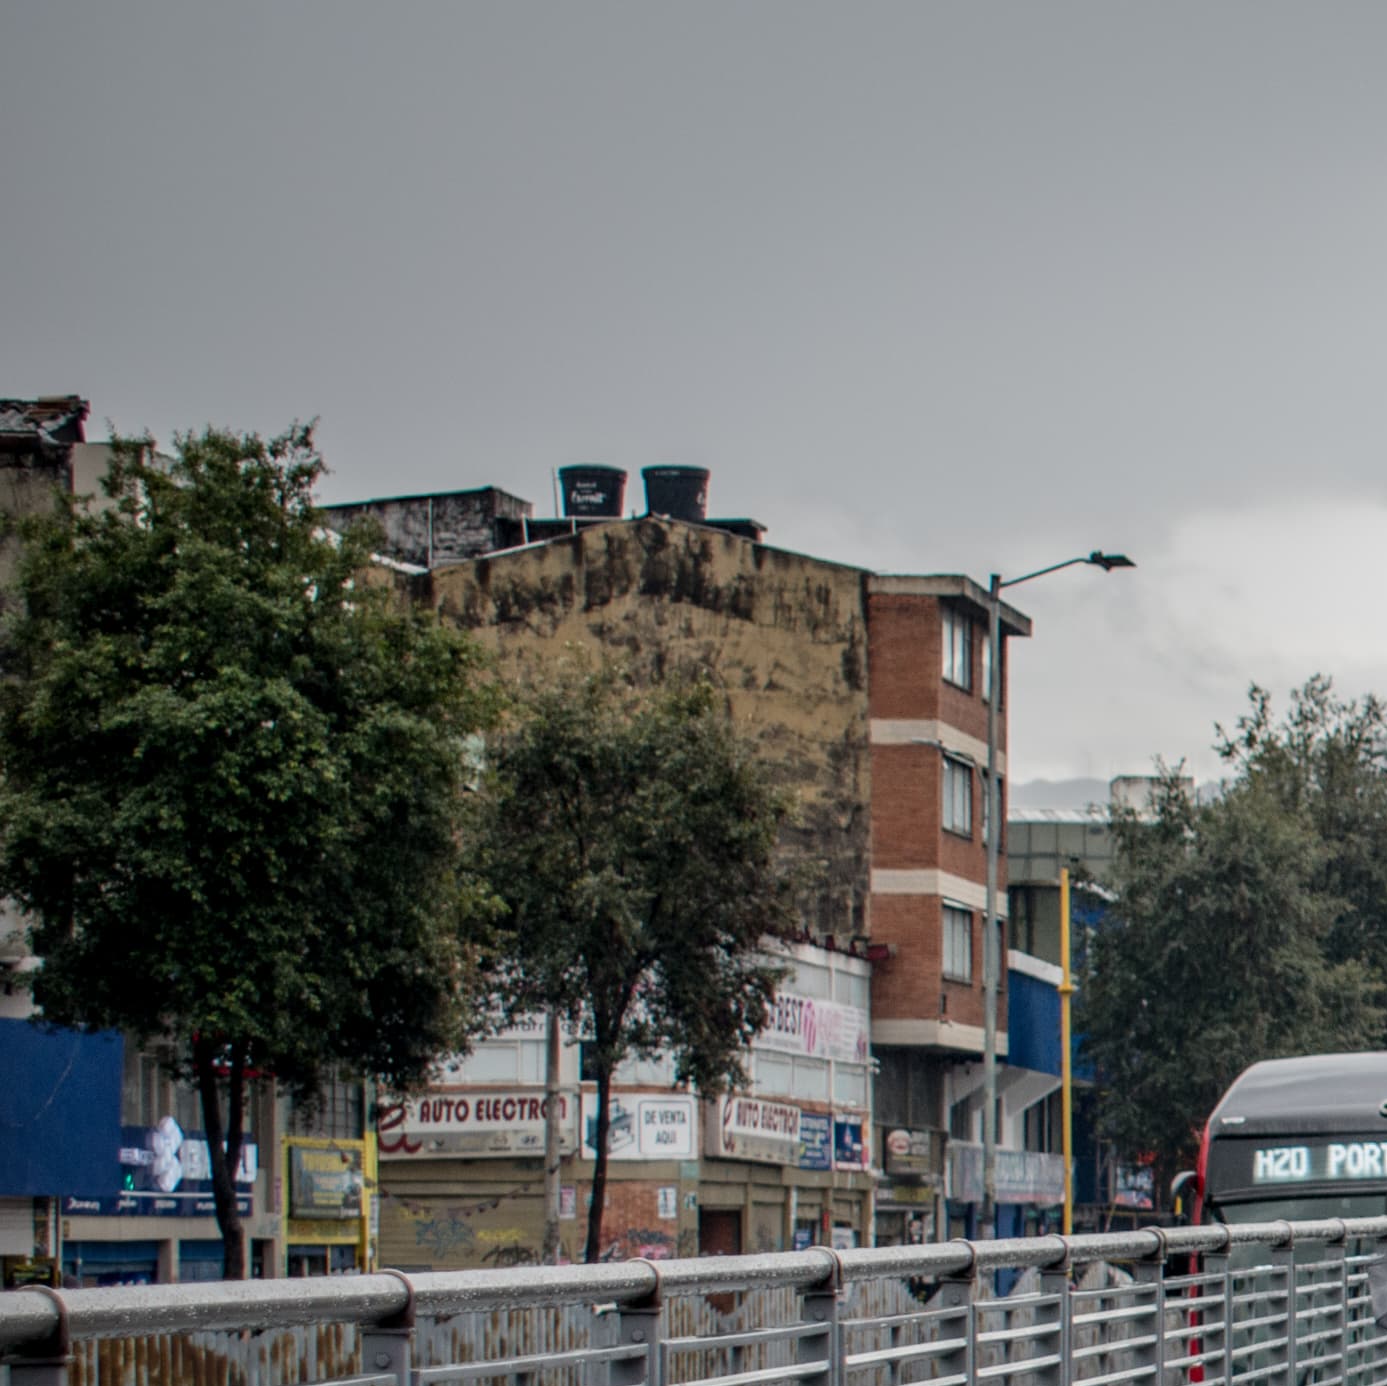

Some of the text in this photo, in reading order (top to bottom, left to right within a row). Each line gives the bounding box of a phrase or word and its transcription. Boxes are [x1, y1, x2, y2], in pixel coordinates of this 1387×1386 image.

[420, 1100, 469, 1122] AUTO
[644, 1109, 687, 1125] DE VENTA
[1254, 1147, 1308, 1179] H20
